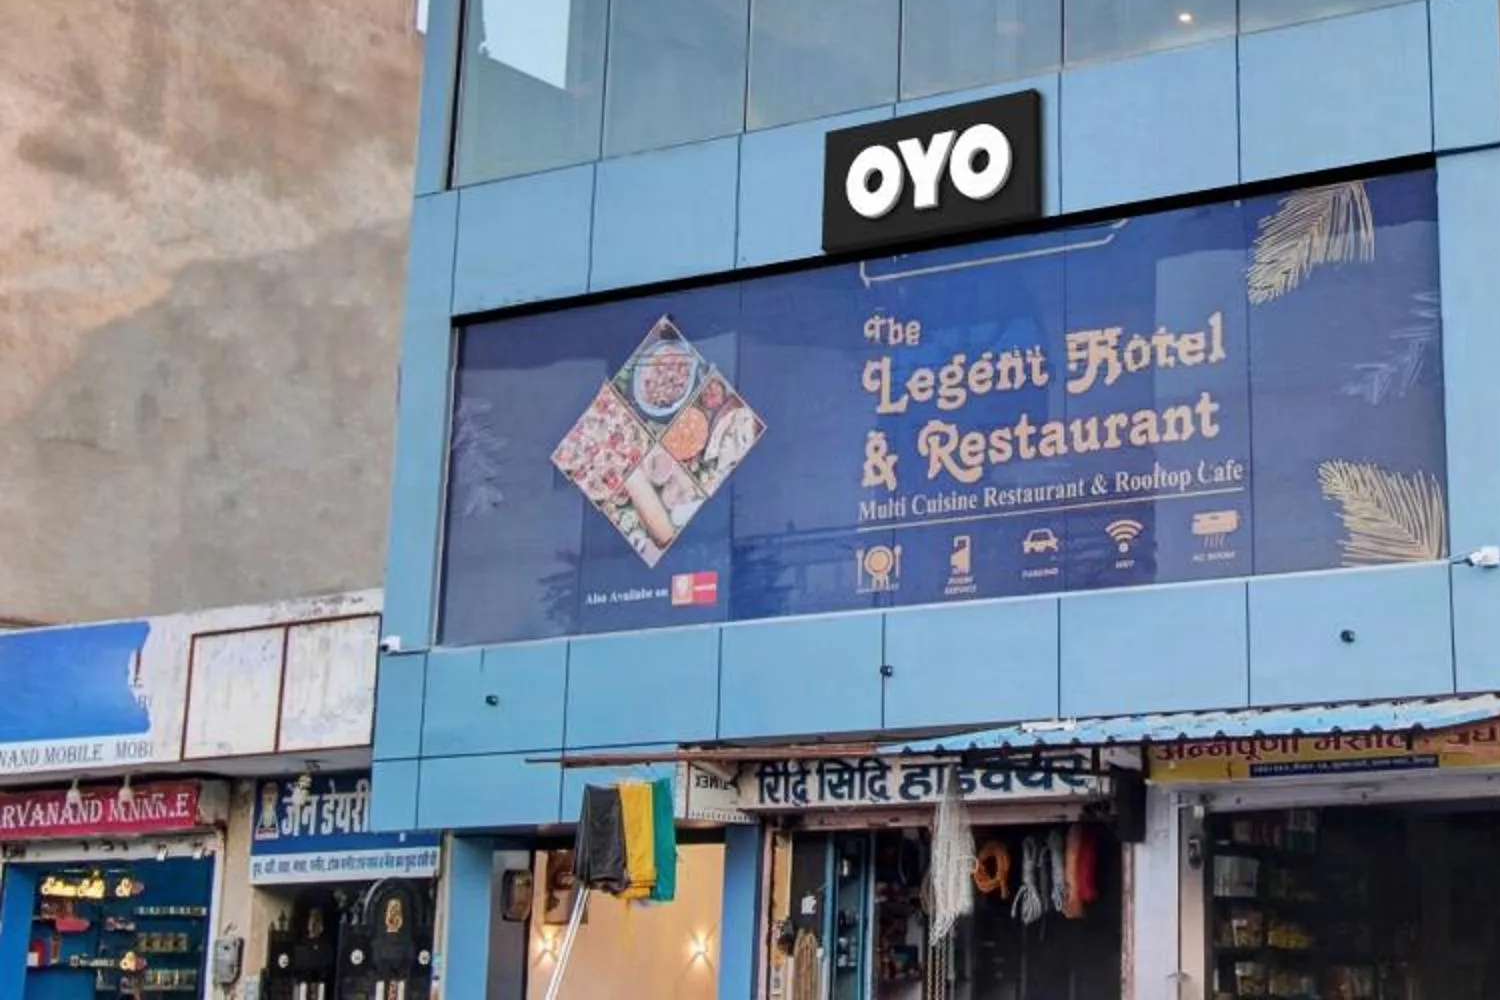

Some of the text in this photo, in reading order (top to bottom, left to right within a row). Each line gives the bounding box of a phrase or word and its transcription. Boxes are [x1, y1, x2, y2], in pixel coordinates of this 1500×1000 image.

[847, 123, 1012, 219] OYO
[862, 310, 1226, 414] Legent Hotel
[863, 313, 921, 346] The
[861, 391, 1221, 491] & Restaurant
[858, 494, 906, 521] Multi
[911, 492, 978, 515] Cuisine
[983, 478, 1085, 508] Restaurant
[1091, 473, 1109, 495] &
[1115, 461, 1192, 492] Rooftop
[43, 743, 103, 767] MOBILE
